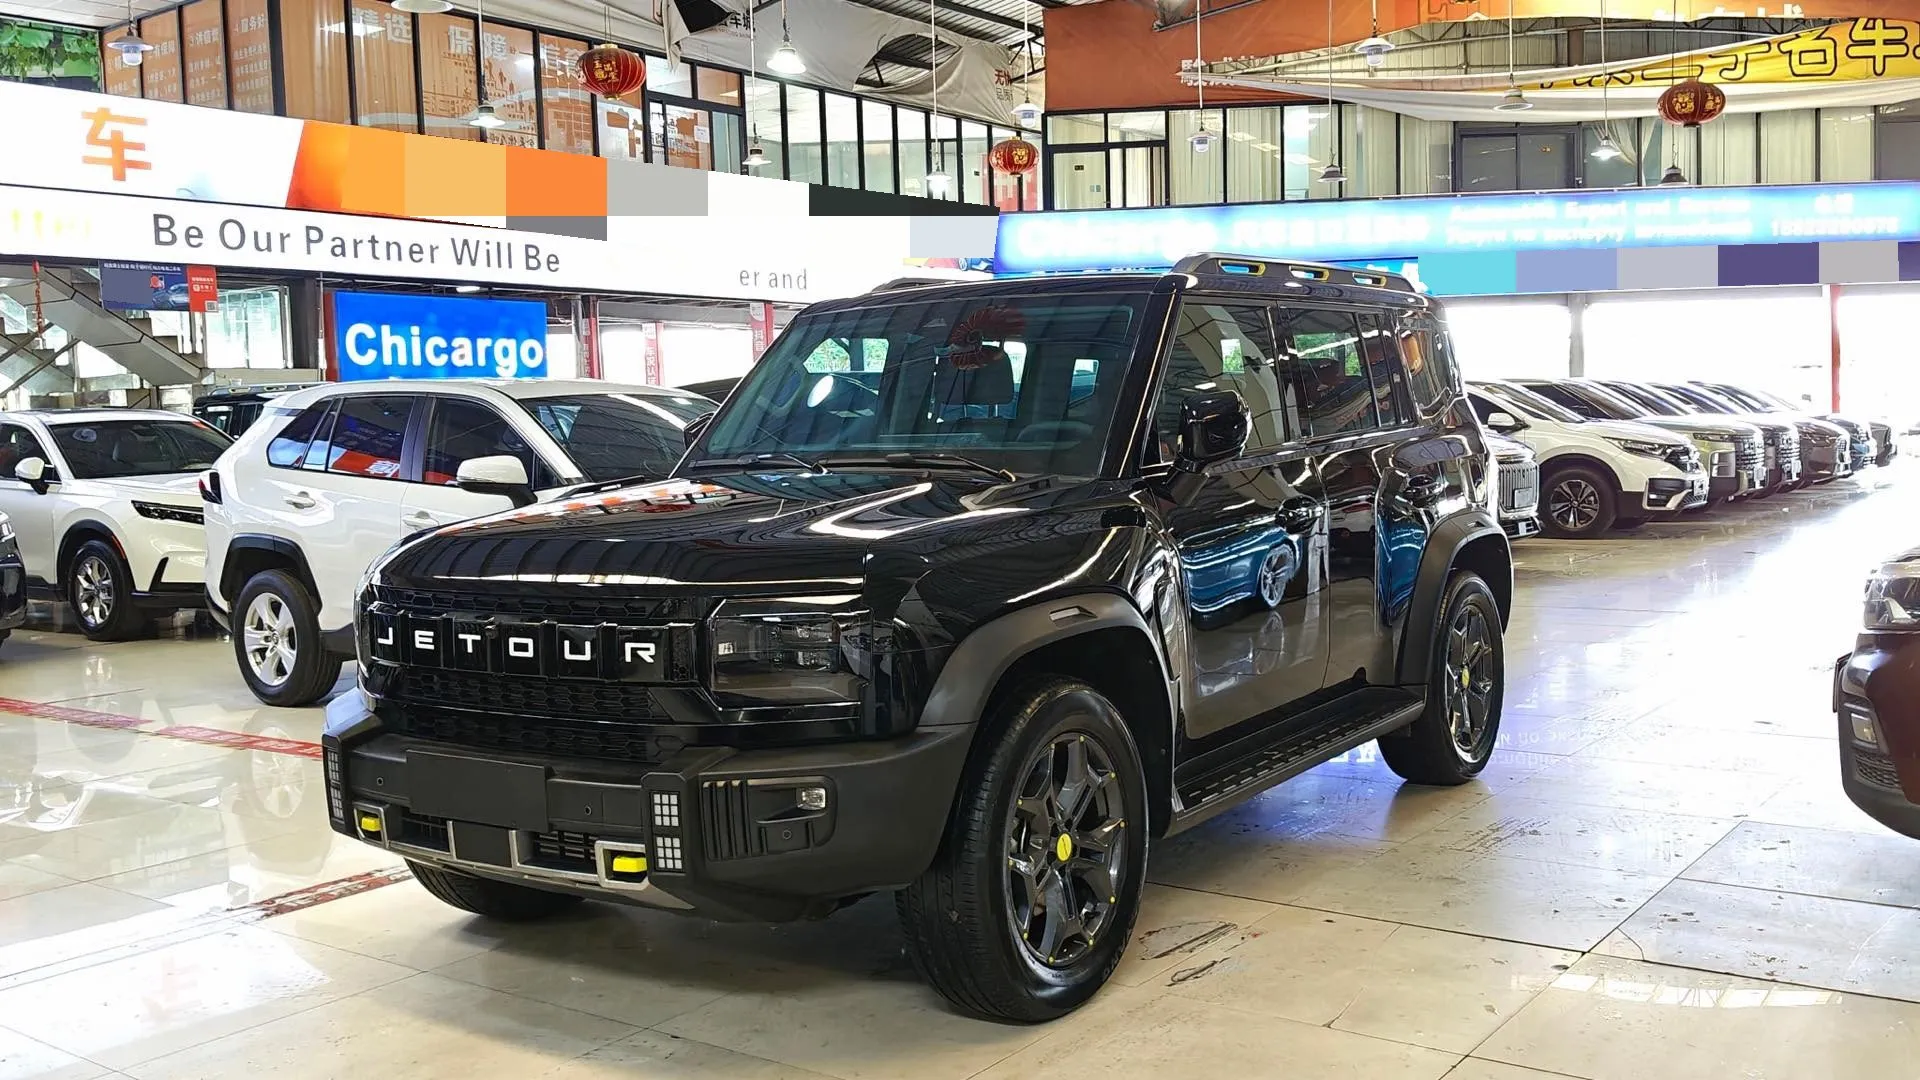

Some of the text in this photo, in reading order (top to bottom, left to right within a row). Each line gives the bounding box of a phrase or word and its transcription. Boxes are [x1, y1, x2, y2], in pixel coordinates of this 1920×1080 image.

[82, 107, 152, 182] 车
[153, 213, 204, 249] Be
[218, 218, 292, 254] Our
[305, 225, 440, 265] Partner
[450, 237, 513, 269] Will
[524, 243, 561, 273] Be
[768, 268, 808, 291] and
[345, 322, 544, 378] Chicargo
[377, 627, 657, 664] JETOUR
